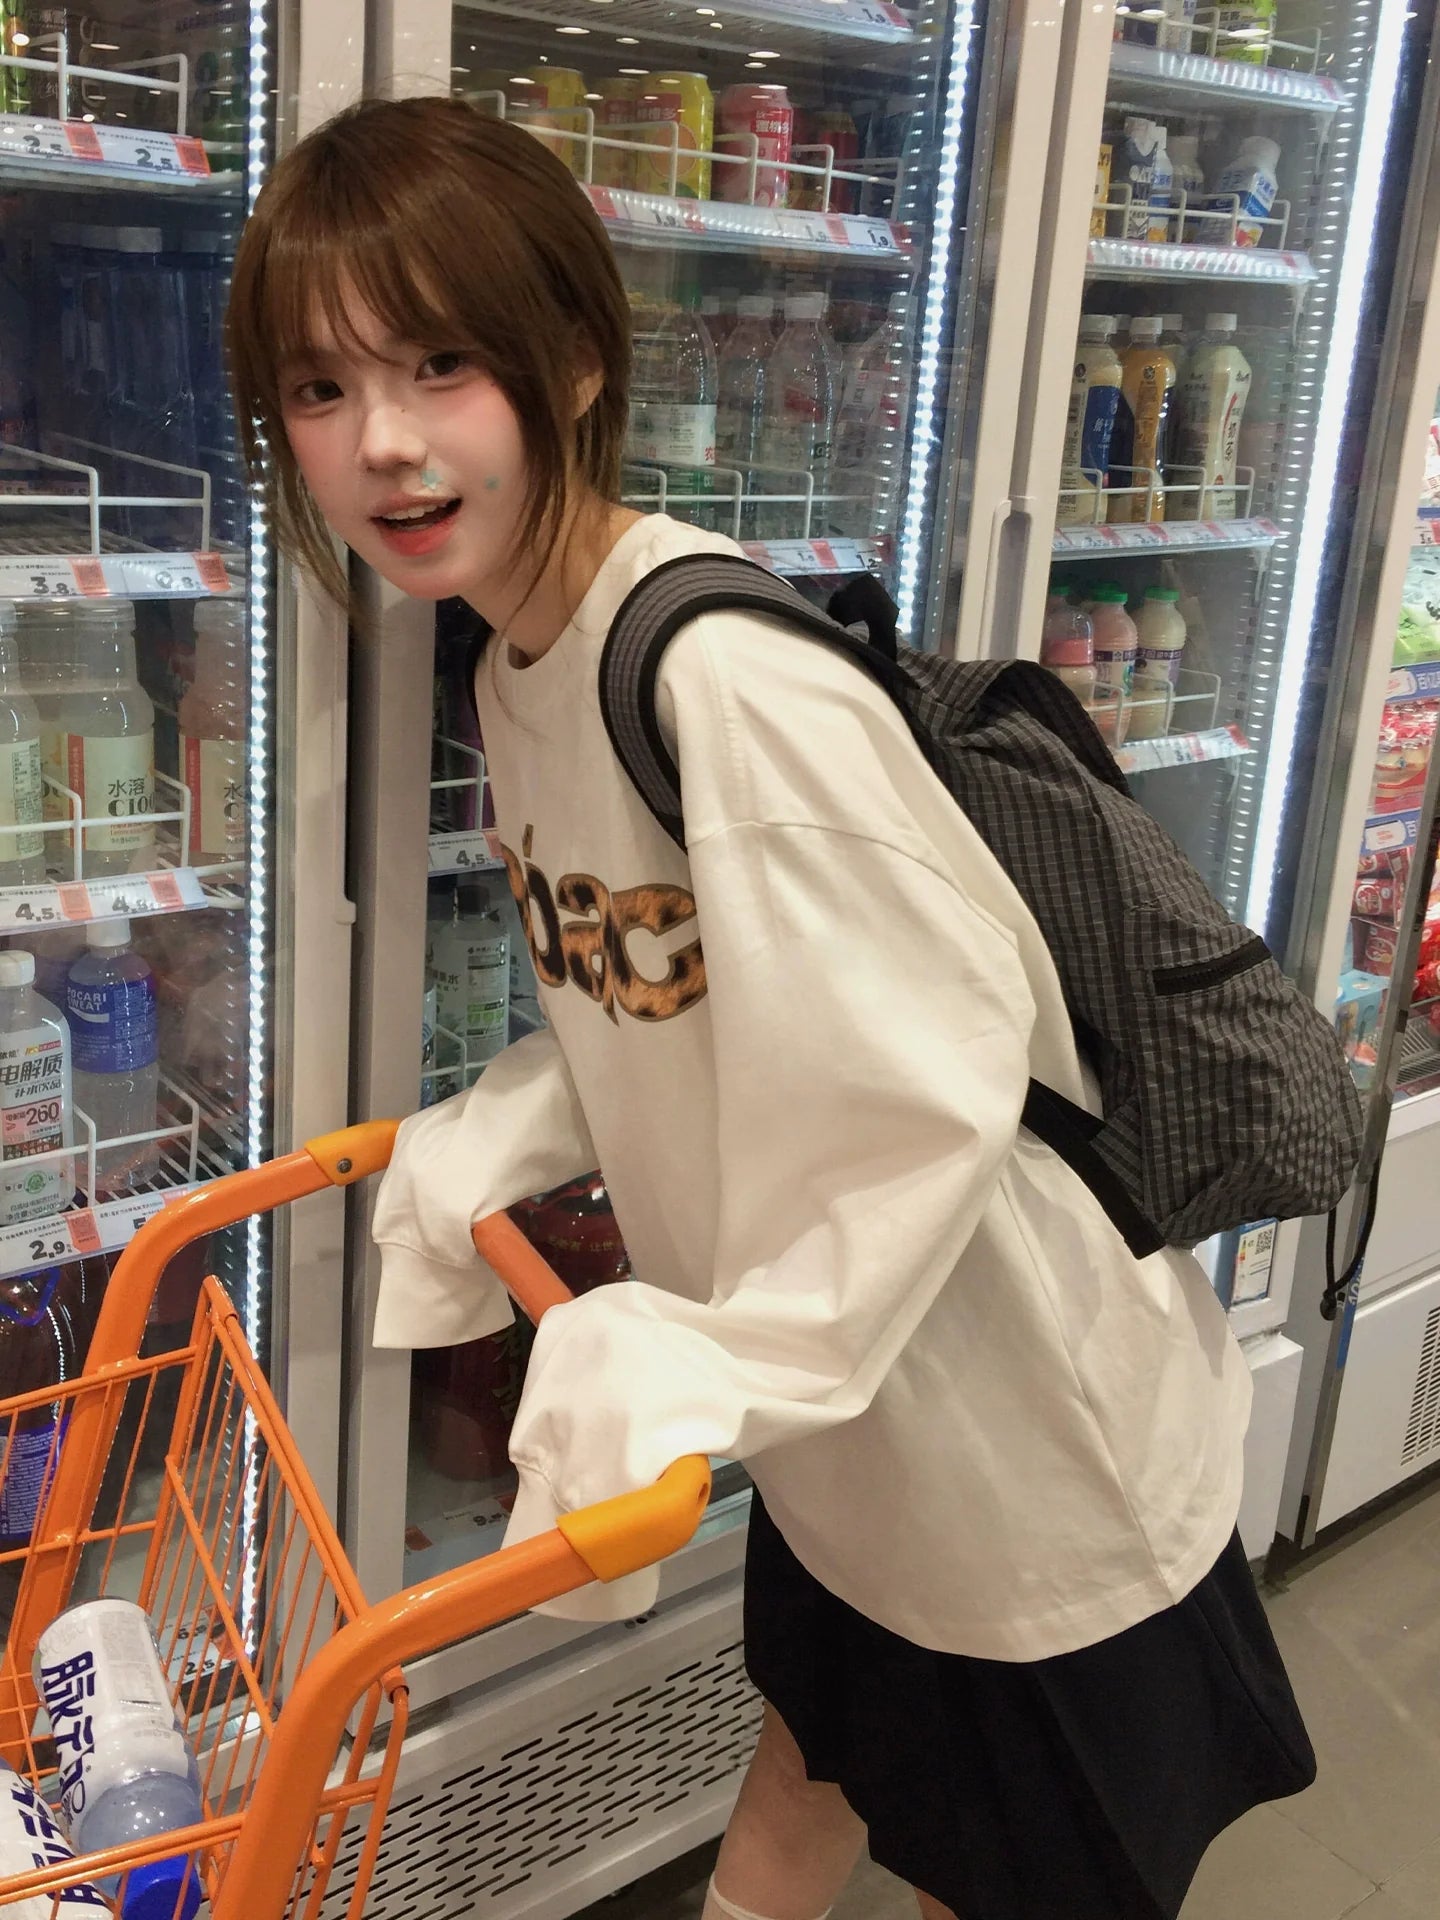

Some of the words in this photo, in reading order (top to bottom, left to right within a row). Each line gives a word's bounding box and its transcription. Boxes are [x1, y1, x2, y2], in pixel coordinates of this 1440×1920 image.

[134, 148, 173, 171] 2.5
[867, 229, 889, 247] 1.9
[108, 778, 145, 798] 水溶
[456, 850, 485, 867] 4.5
[15, 903, 55, 922] 4.5
[0, 1053, 64, 1085] 电解质
[26, 1102, 60, 1126] 260
[29, 1240, 65, 1260] 2.9
